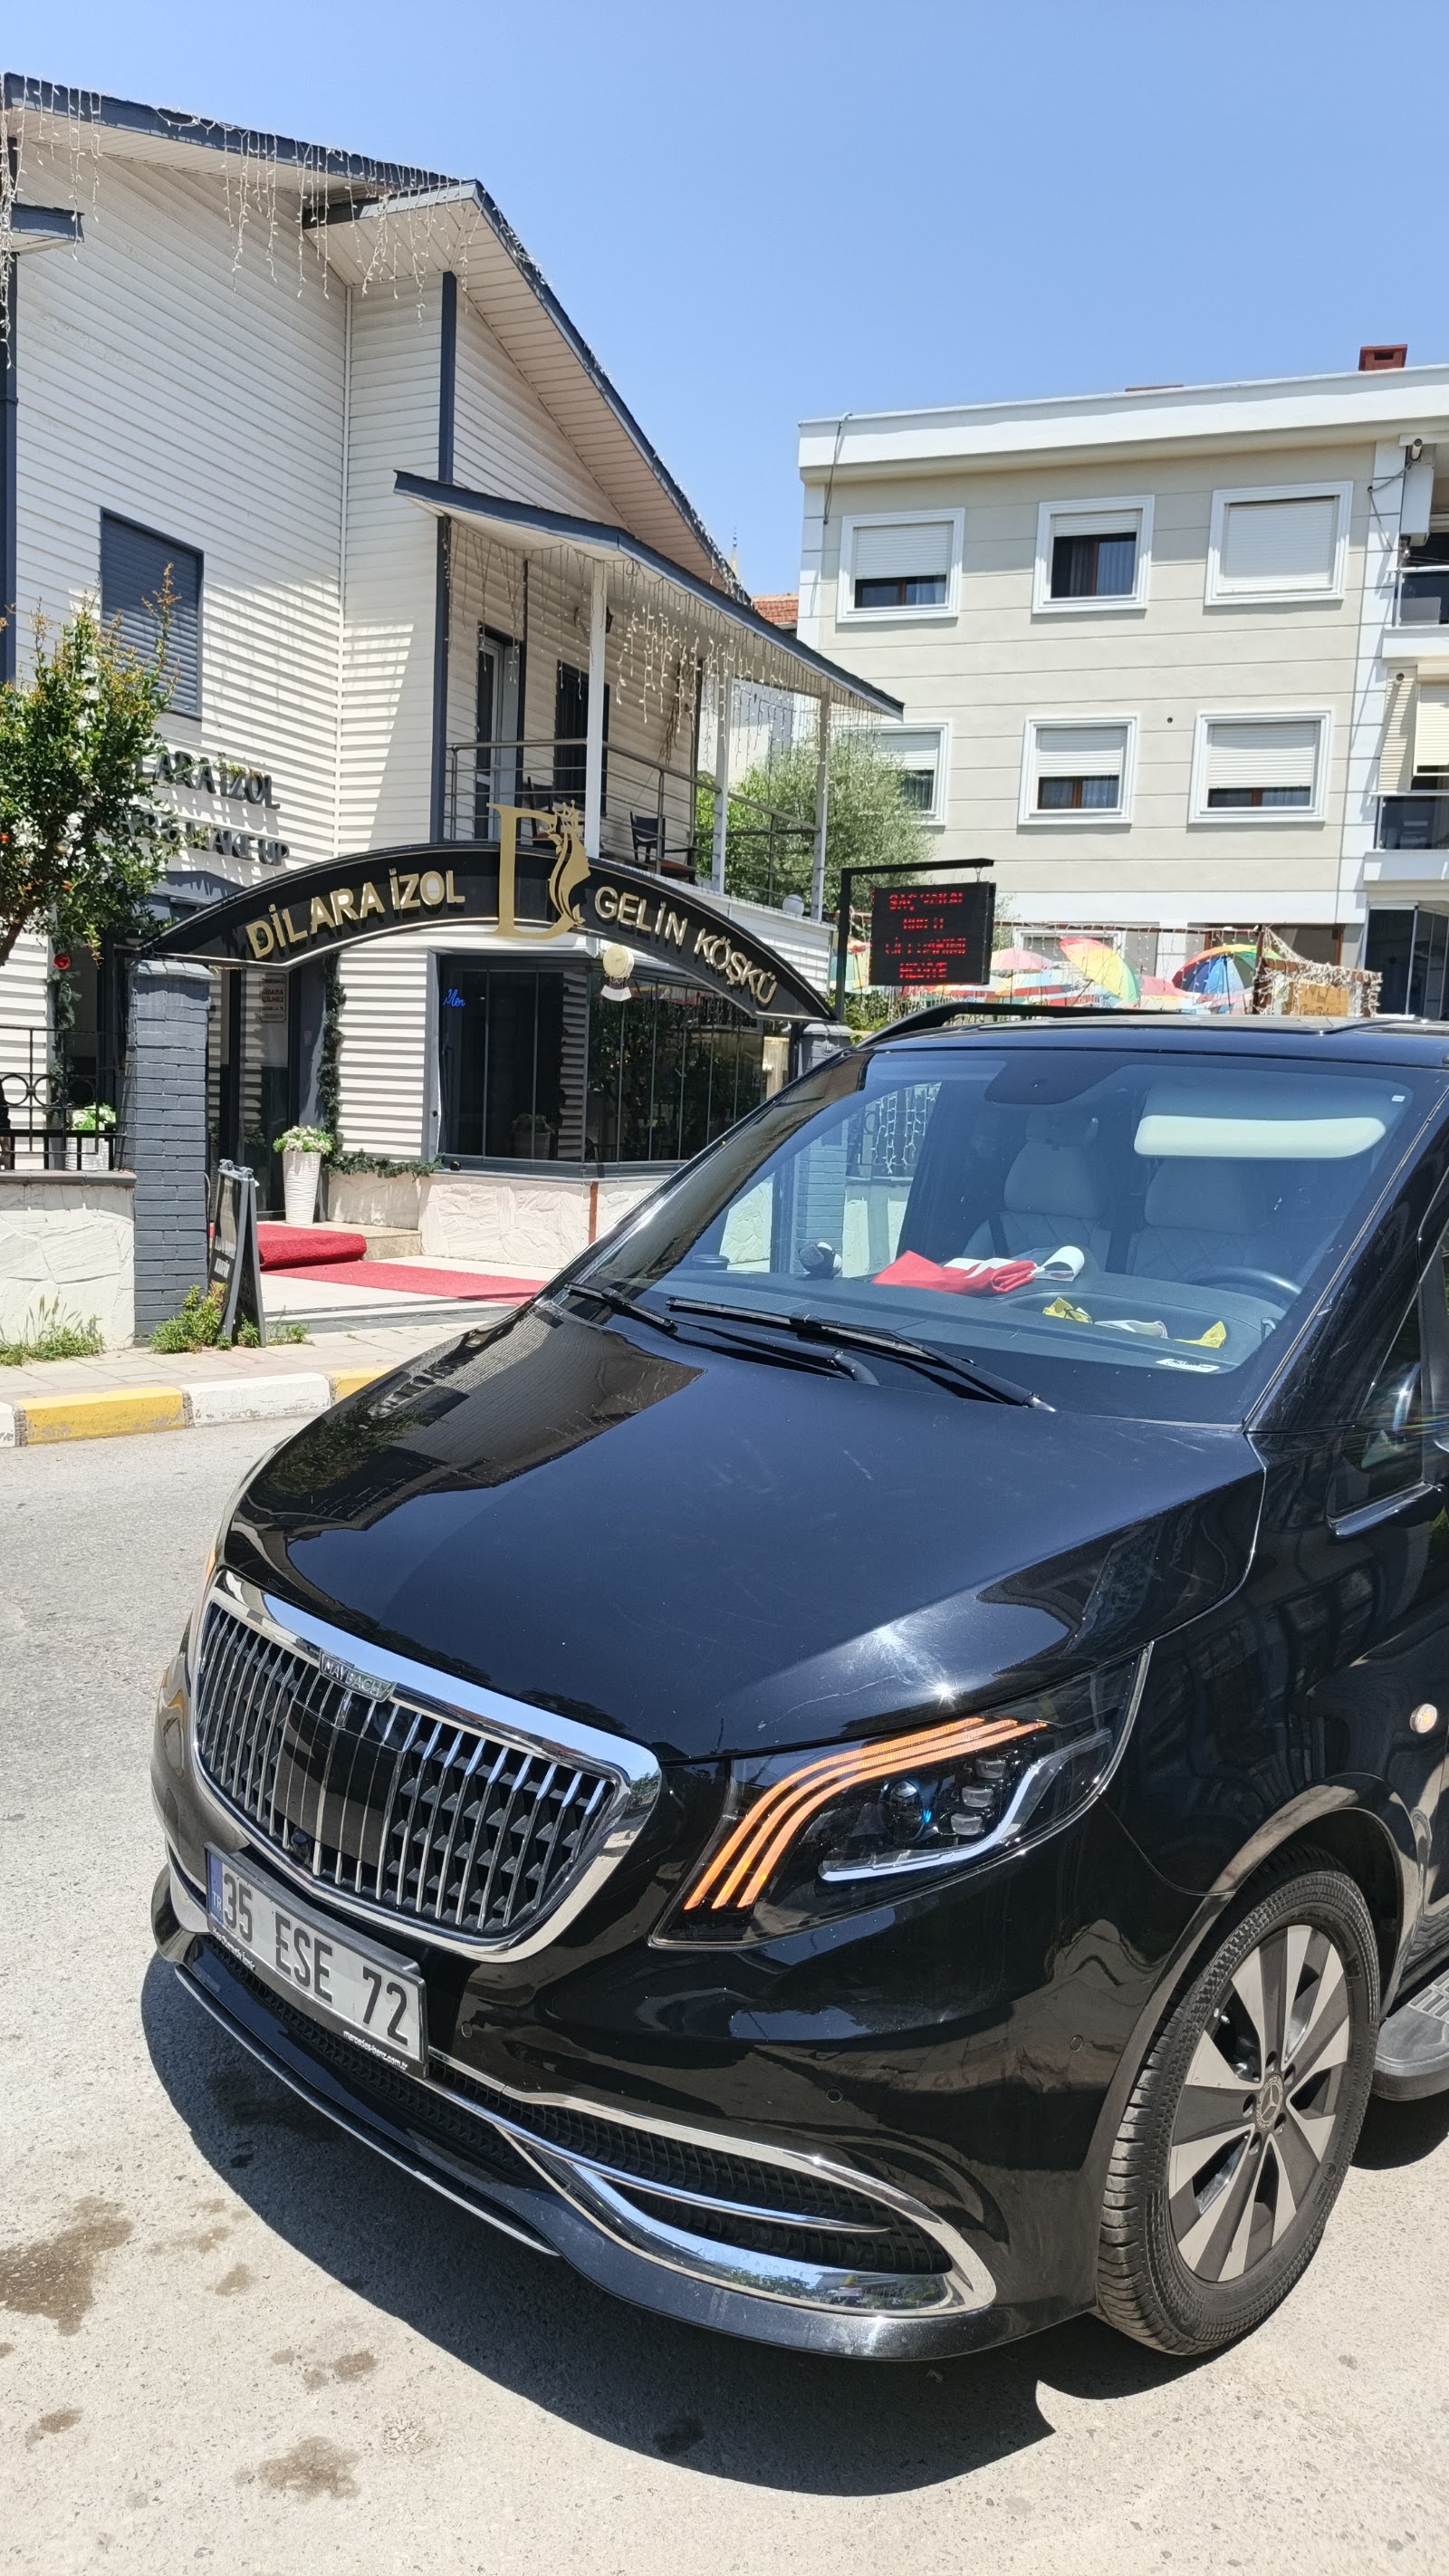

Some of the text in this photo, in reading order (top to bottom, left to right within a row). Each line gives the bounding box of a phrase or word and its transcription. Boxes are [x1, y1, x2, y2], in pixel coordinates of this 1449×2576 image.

[245, 867, 465, 960] DİLARA İZOL
[594, 885, 778, 1004] GELİN KÖŞKÜ
[212, 1890, 223, 1912] TR
[224, 1872, 408, 2048] 35 ESE 72
